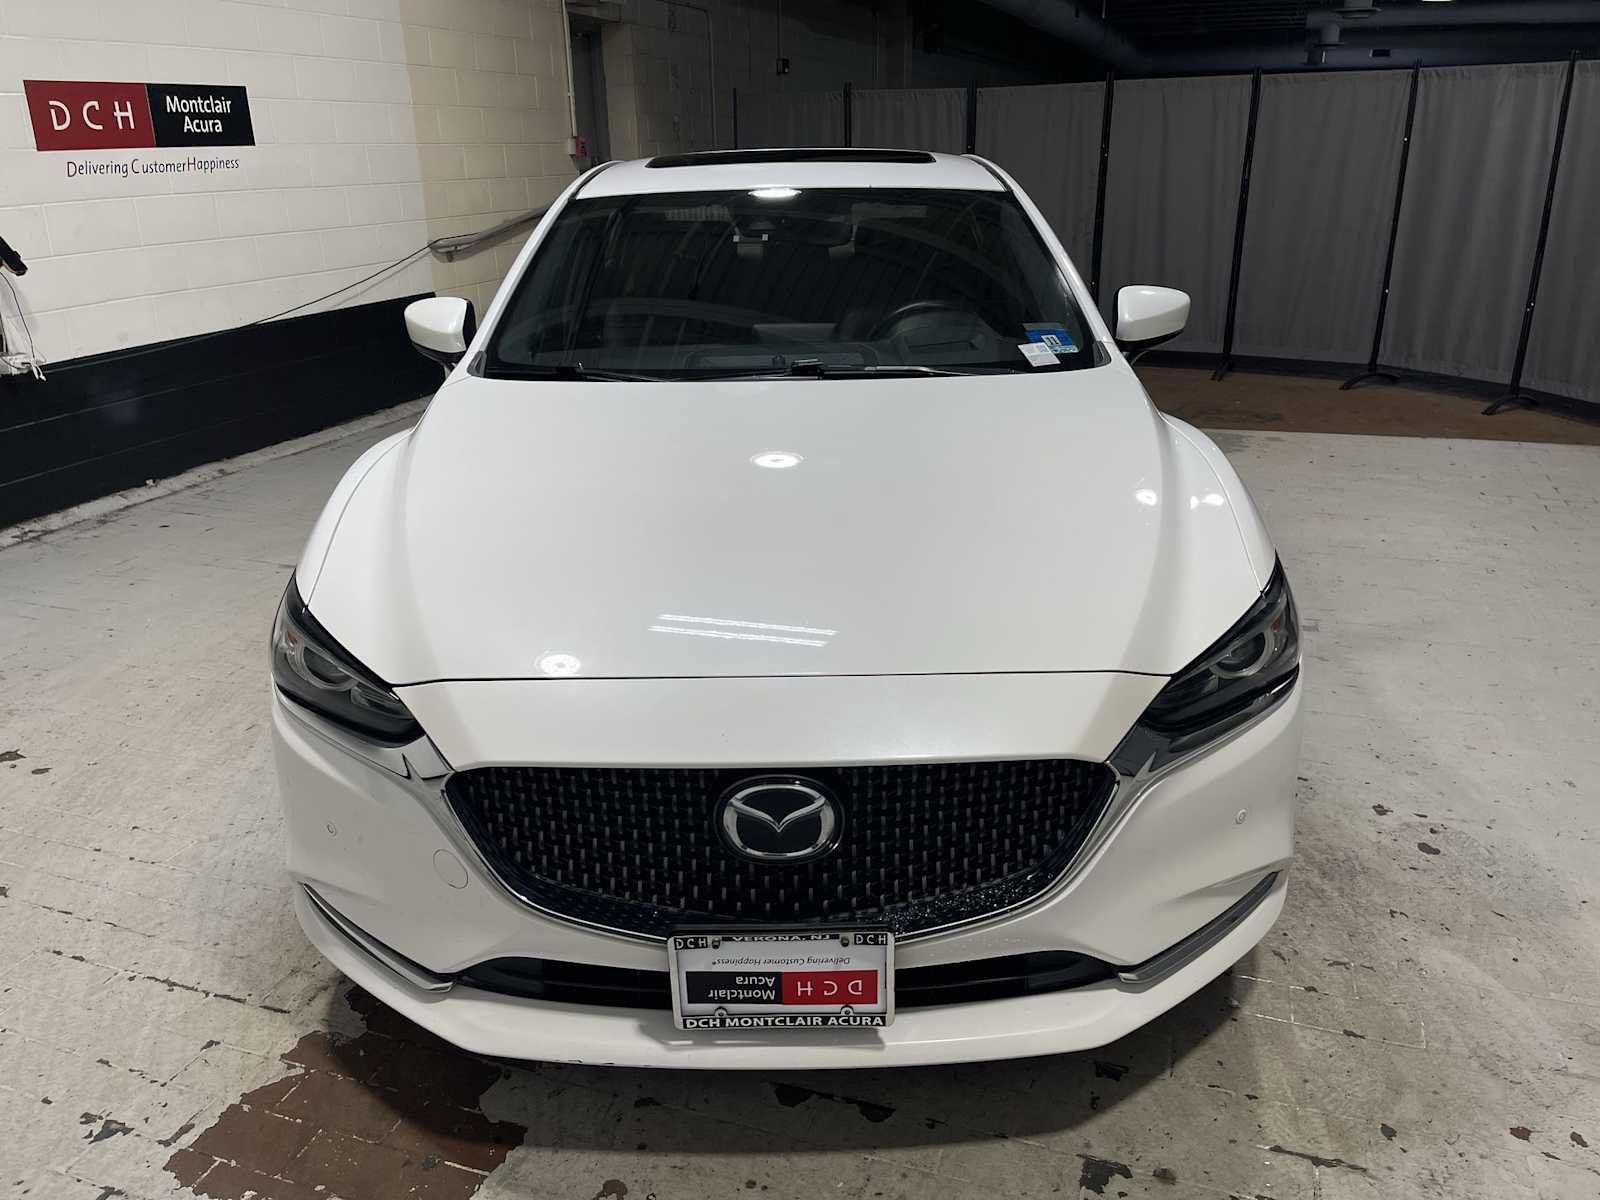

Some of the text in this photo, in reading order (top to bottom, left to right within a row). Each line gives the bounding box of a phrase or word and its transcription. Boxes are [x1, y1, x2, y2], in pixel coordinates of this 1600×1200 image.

[166, 95, 232, 114] Montclair
[184, 115, 223, 133] Acura
[66, 156, 240, 178] Delivering Customer Happiness
[675, 938, 707, 949] DCH
[855, 934, 887, 944] DCH
[763, 957, 805, 966] Customer
[807, 955, 851, 966] Delivering
[735, 976, 776, 987] Acura
[797, 979, 863, 997] DCH
[707, 989, 776, 1001] Montclair
[686, 1016, 884, 1028] DCH MONTCLAIR ACURA
